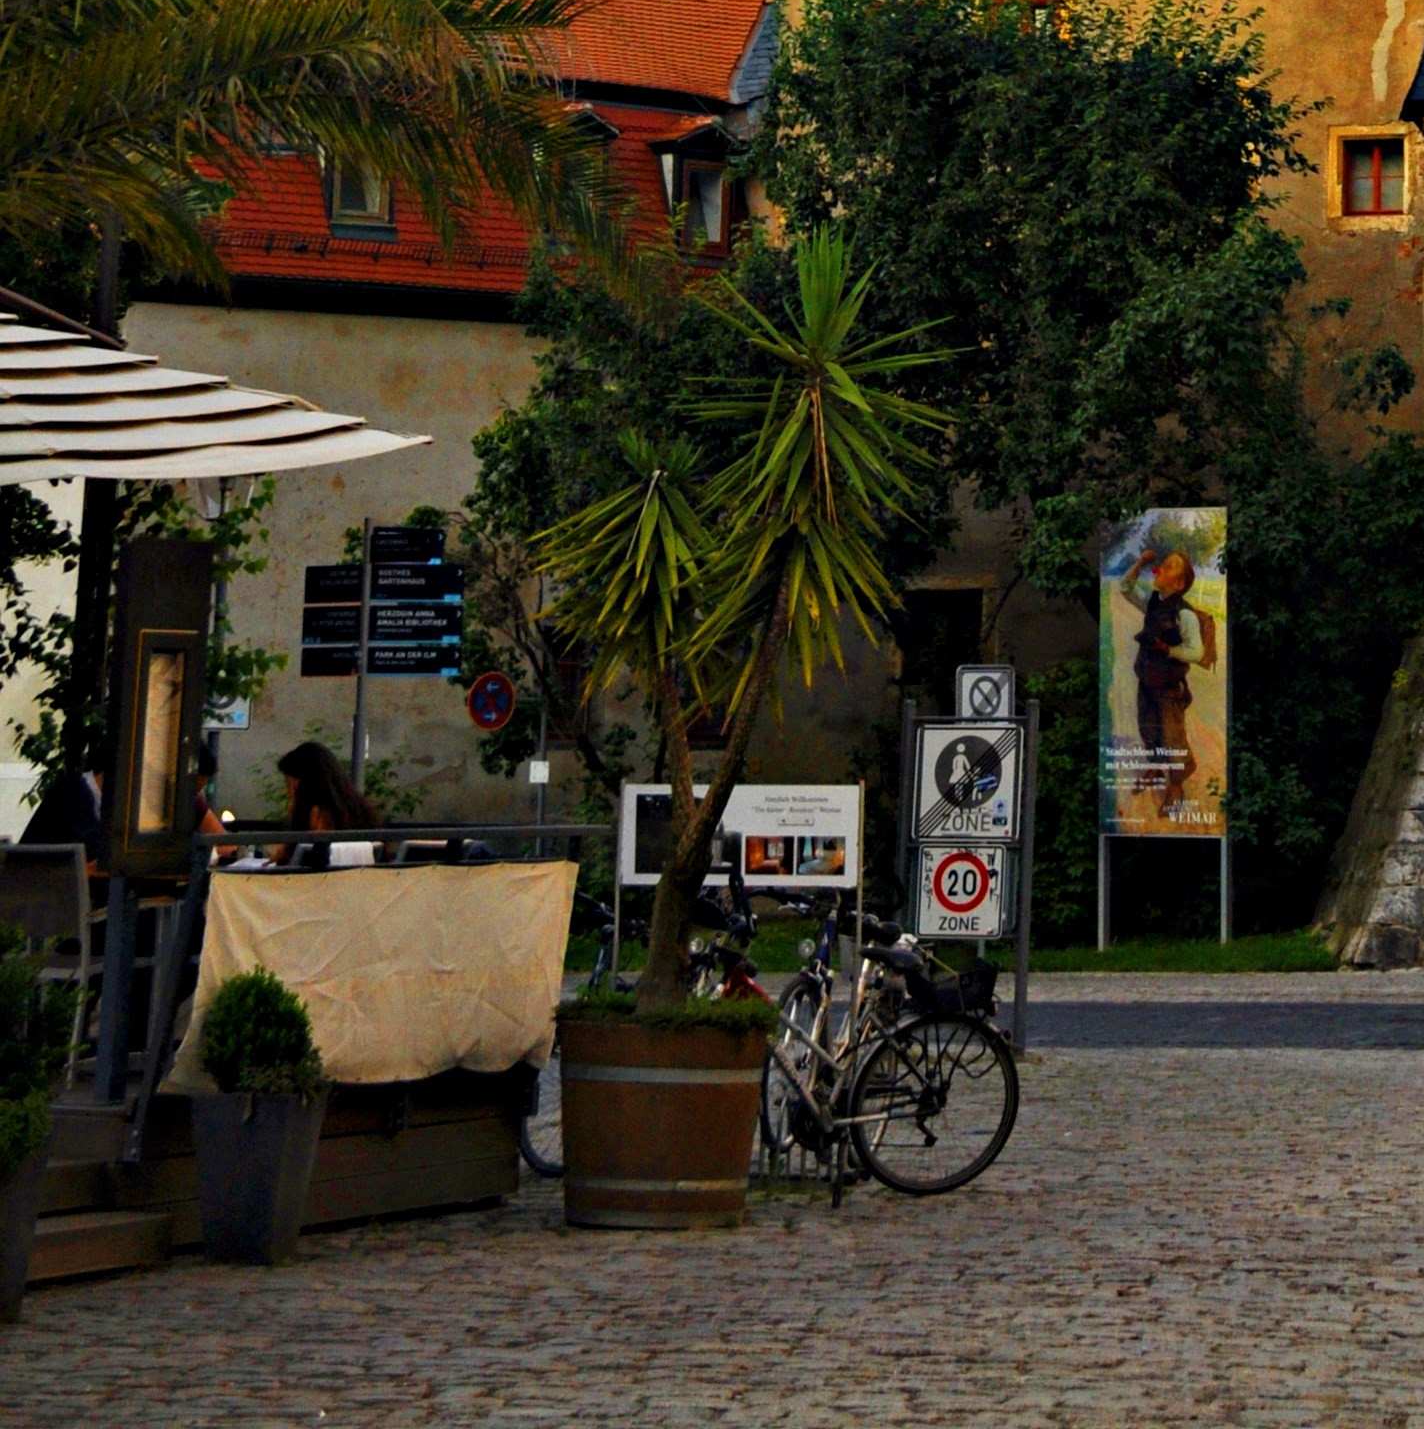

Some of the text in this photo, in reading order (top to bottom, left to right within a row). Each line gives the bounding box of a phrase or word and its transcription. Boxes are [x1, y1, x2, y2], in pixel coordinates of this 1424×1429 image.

[378, 569, 411, 577] GOETHES
[378, 577, 426, 586] GARTENHAUS
[376, 610, 436, 618] HERZOGIN ANNA
[376, 619, 448, 627] AMALIA BIBLIOTHEK
[374, 651, 437, 659] PARK AN DER ILM
[1105, 746, 1188, 757] Stadtschloss Weimar
[1105, 759, 1185, 770] mit Schlossmuseum
[941, 813, 991, 832] ZONE
[1168, 812, 1217, 824] WEIMAR
[947, 869, 977, 896] 20
[938, 916, 981, 931] ZONE
